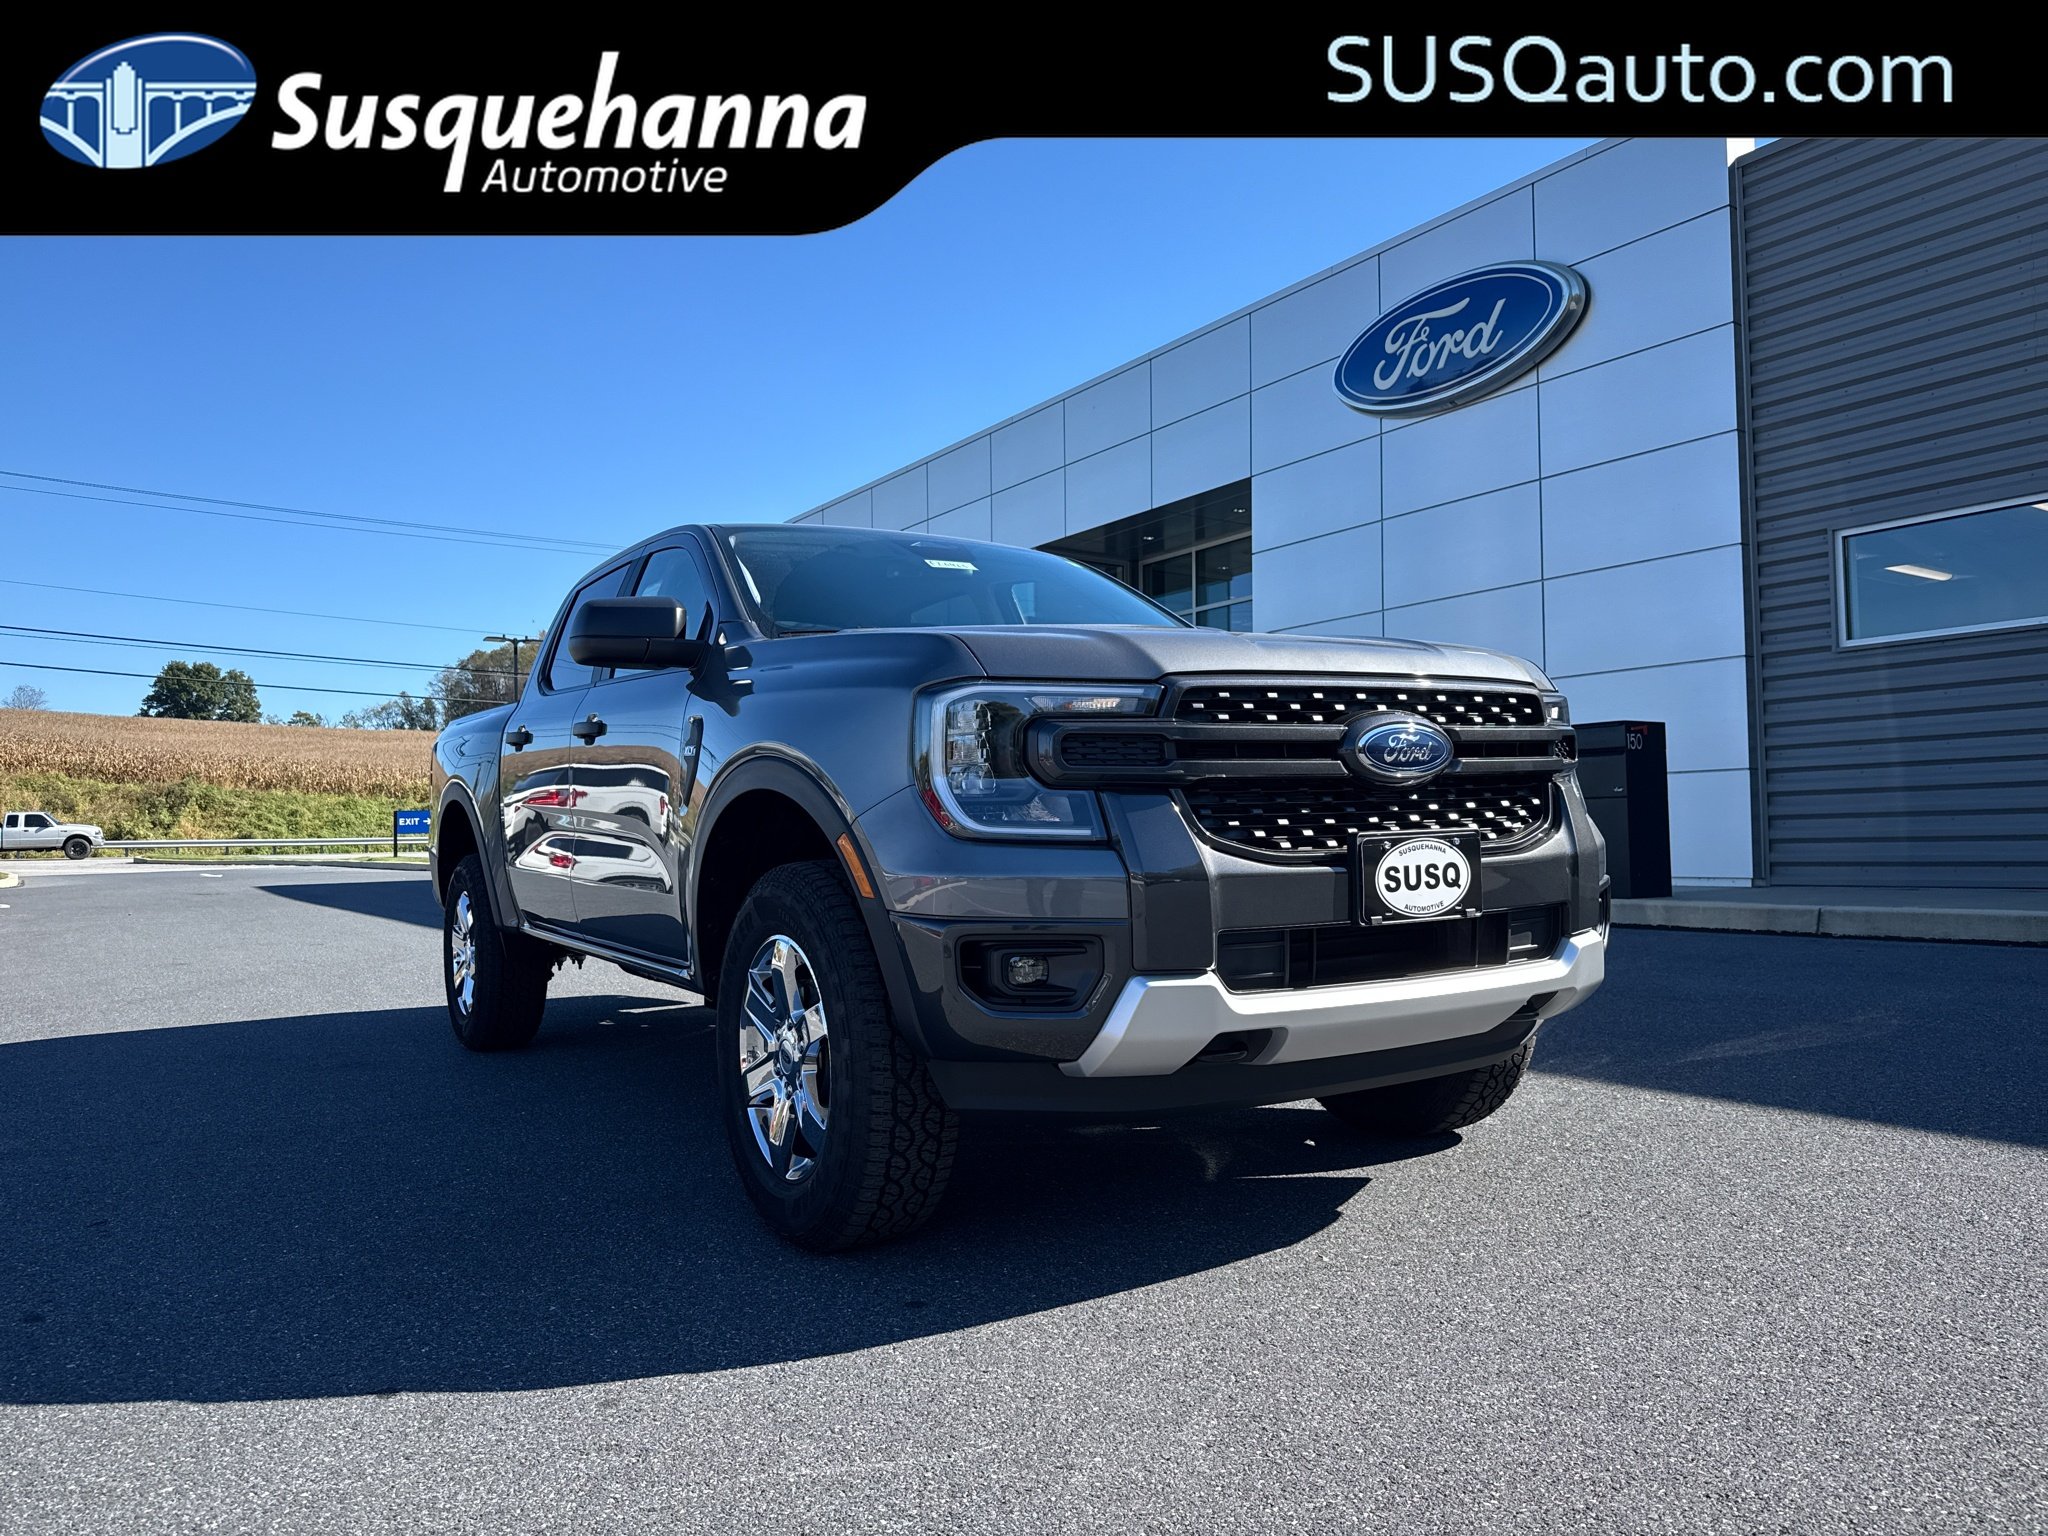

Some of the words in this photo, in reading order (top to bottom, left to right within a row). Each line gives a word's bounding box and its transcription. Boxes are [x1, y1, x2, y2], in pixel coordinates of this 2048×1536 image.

[1373, 297, 1506, 391] Ford
[1384, 733, 1432, 762] Ford
[1627, 733, 1643, 750] 150
[399, 817, 420, 826] EXIT
[1398, 843, 1447, 857] SUSQUEHANNA
[1384, 862, 1462, 893] SUSQ
[1403, 900, 1445, 913] AUTOMOTIVE
